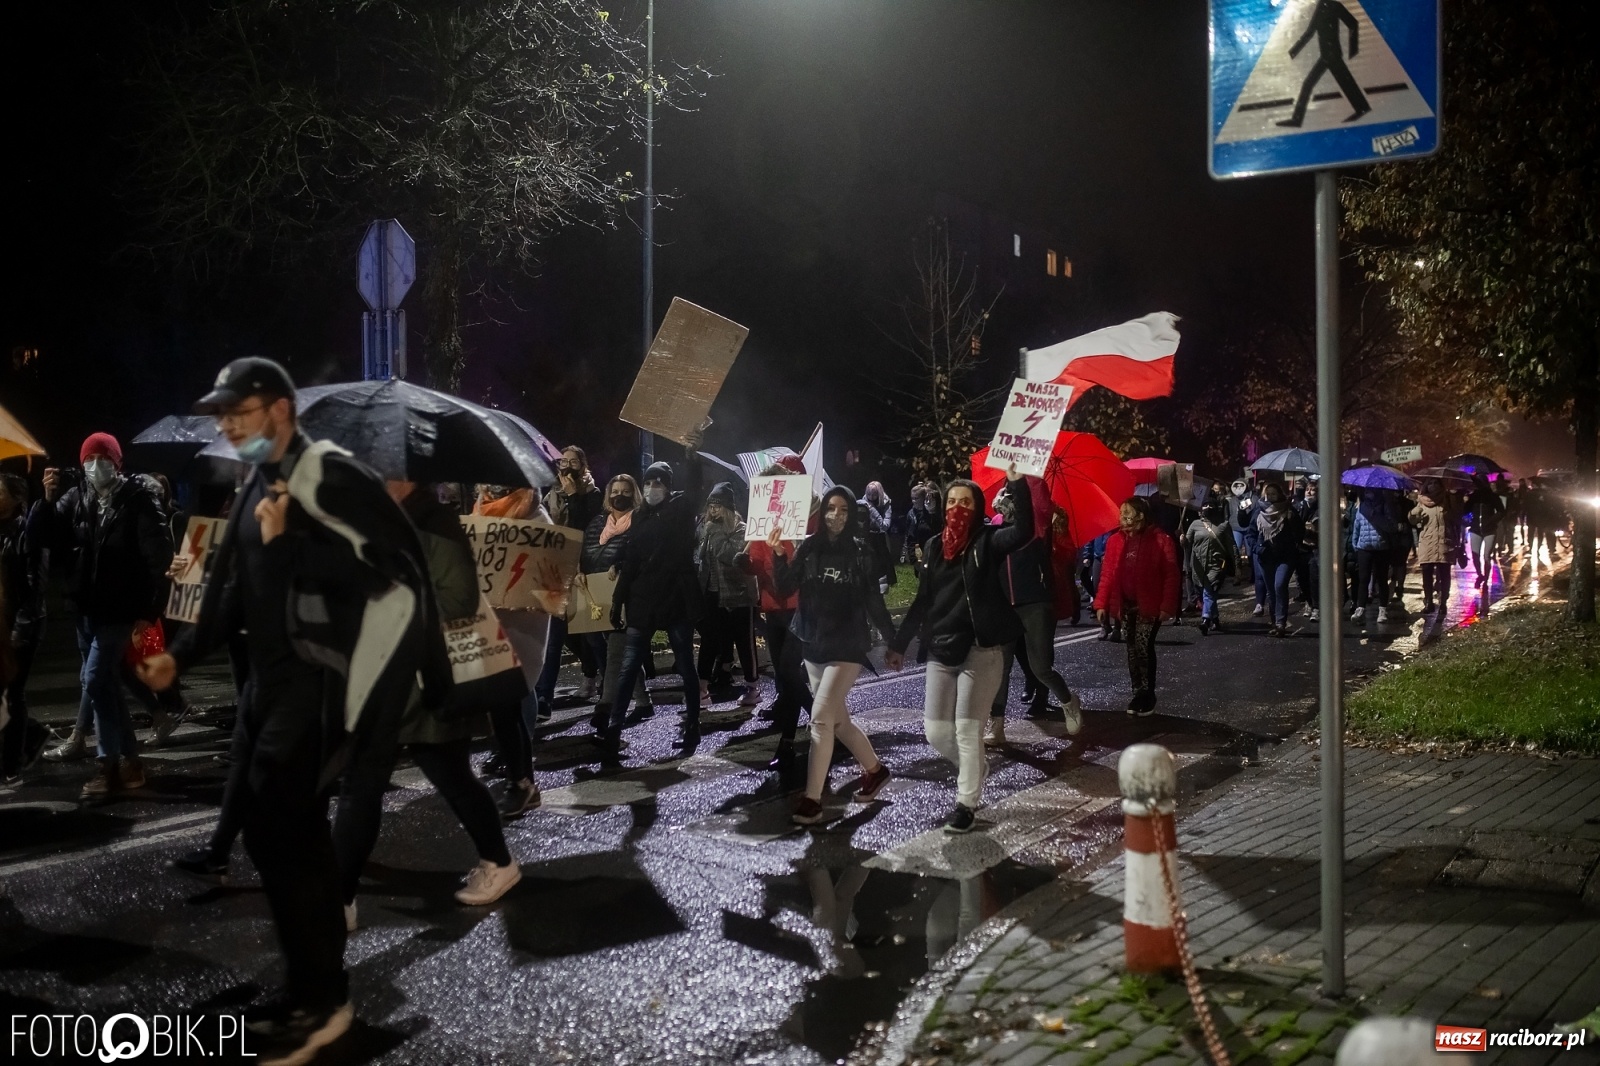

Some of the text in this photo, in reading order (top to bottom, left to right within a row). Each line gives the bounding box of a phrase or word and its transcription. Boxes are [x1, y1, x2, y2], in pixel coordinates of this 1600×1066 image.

[1026, 382, 1059, 396] NASZA
[999, 432, 1012, 445] TO
[484, 522, 566, 550] BROSZKA
